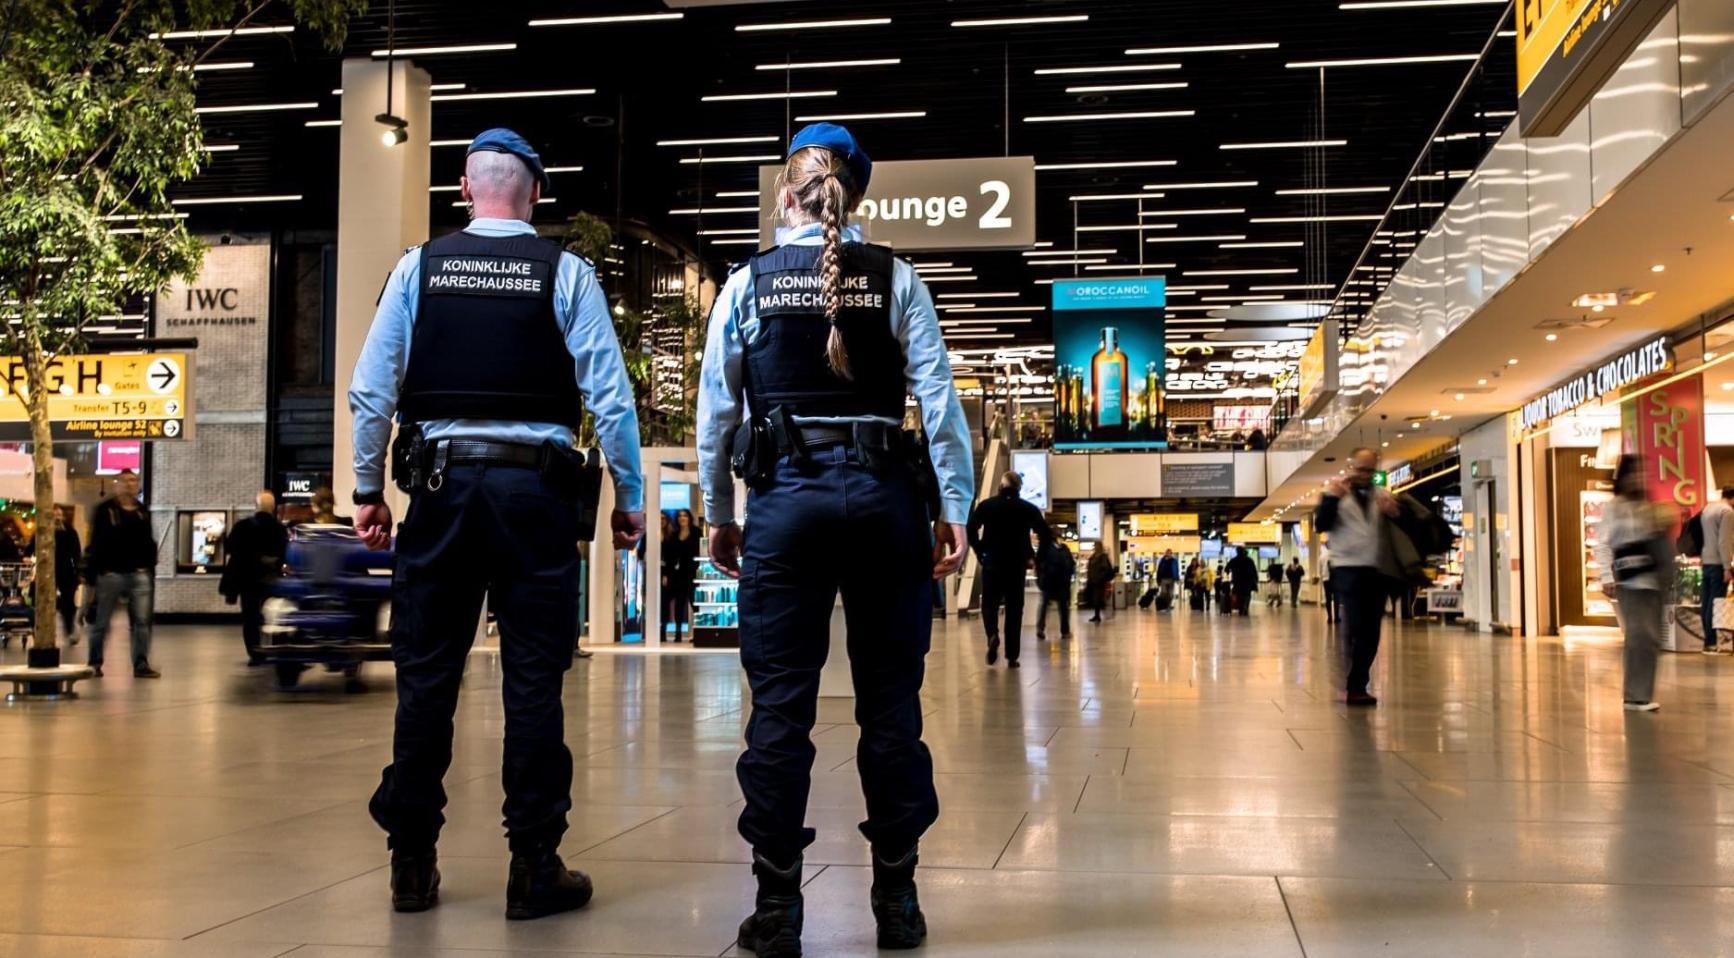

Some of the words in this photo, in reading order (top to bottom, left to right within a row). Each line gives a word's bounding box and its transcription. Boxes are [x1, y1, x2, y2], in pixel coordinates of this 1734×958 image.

[855, 194, 968, 226] ounge
[978, 180, 1012, 229] 2
[442, 260, 531, 275] KONINKLIJKE
[429, 275, 542, 292] MARECHAUSSEE
[772, 275, 868, 290] KONINKJKE
[186, 287, 238, 312] IWC
[166, 317, 256, 327] SCHAFFHAUSEN
[1547, 377, 1585, 418] TOBACCO
[1586, 372, 1595, 400] &
[1596, 336, 1666, 396] CHOCOLATES
[114, 382, 140, 390] Gates
[73, 404, 109, 412] Transfer
[112, 401, 147, 415] T5-9
[66, 420, 98, 431] Airline
[99, 420, 134, 432] lounge
[1649, 389, 1698, 506] SPRING
[288, 479, 311, 492] IWC
